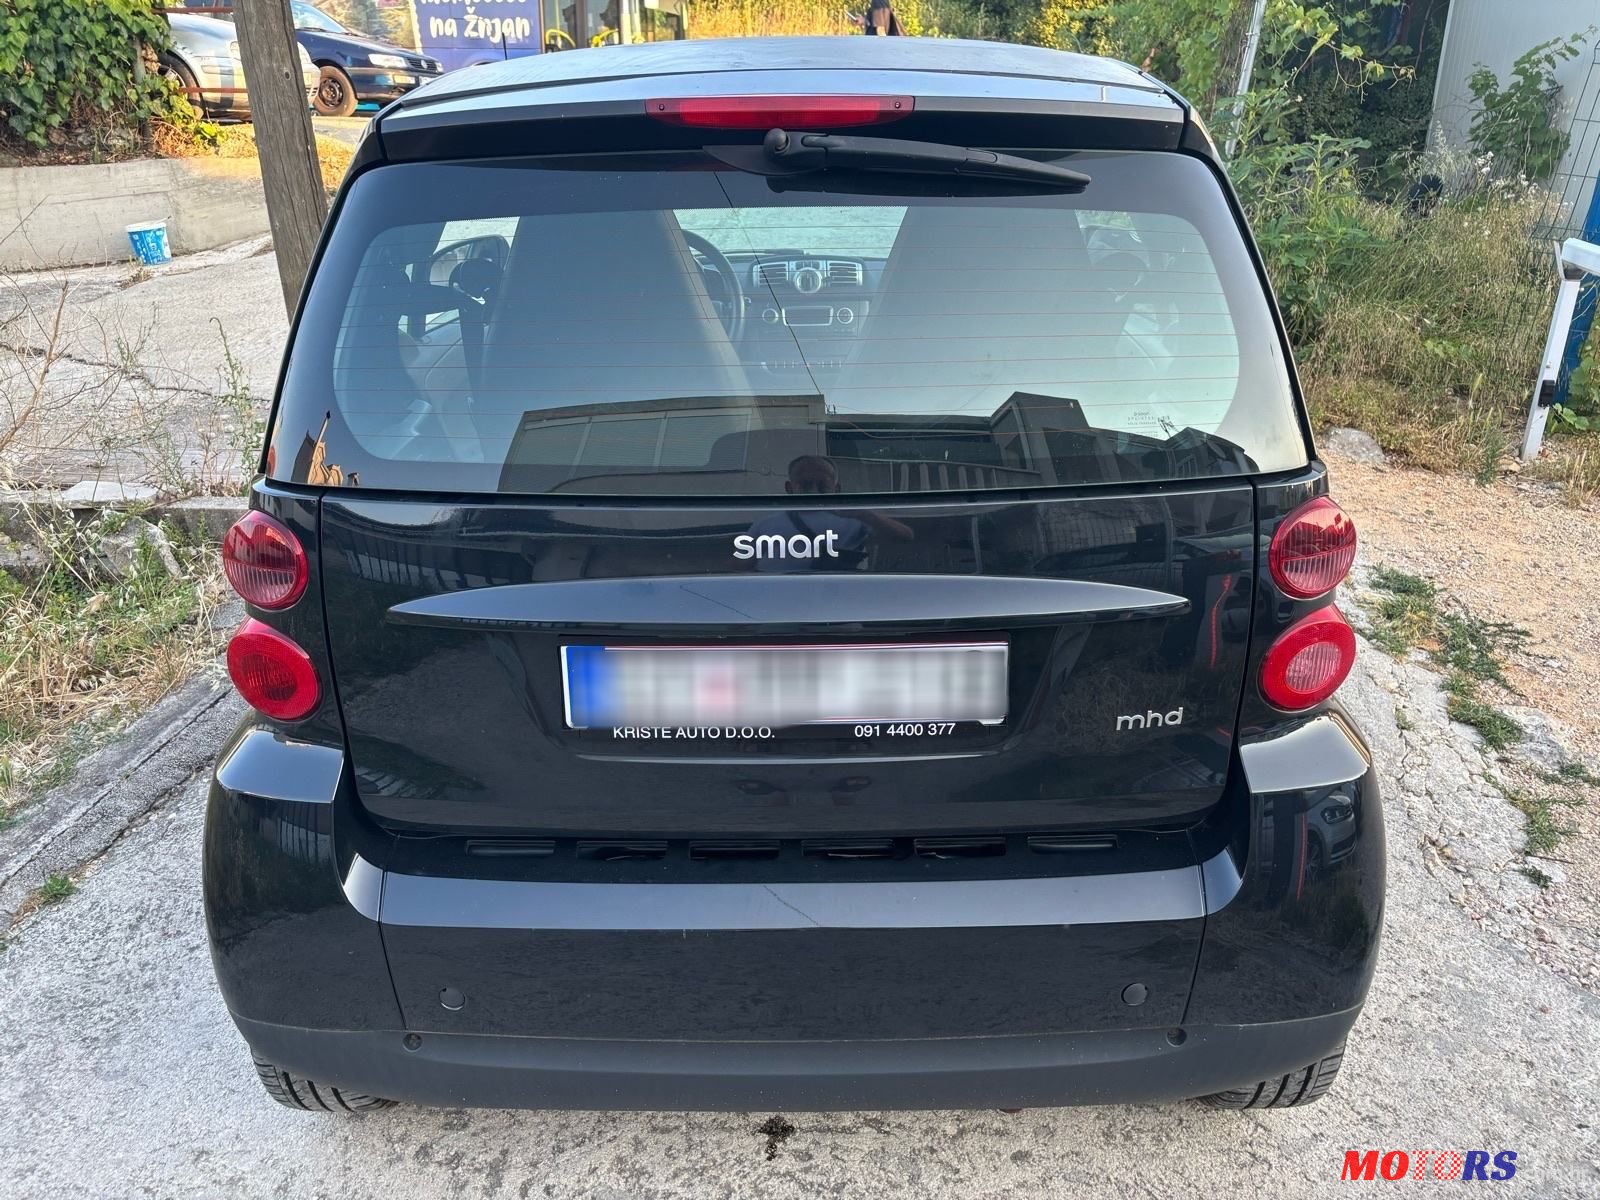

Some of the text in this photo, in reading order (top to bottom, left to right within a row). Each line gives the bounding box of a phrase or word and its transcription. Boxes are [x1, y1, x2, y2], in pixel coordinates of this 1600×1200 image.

[429, 6, 530, 43] na Žnjan
[732, 529, 840, 560] smart
[612, 722, 957, 739] KRISTE AUTO D.O.O. 091 4400 377
[1115, 706, 1185, 731] mhd
